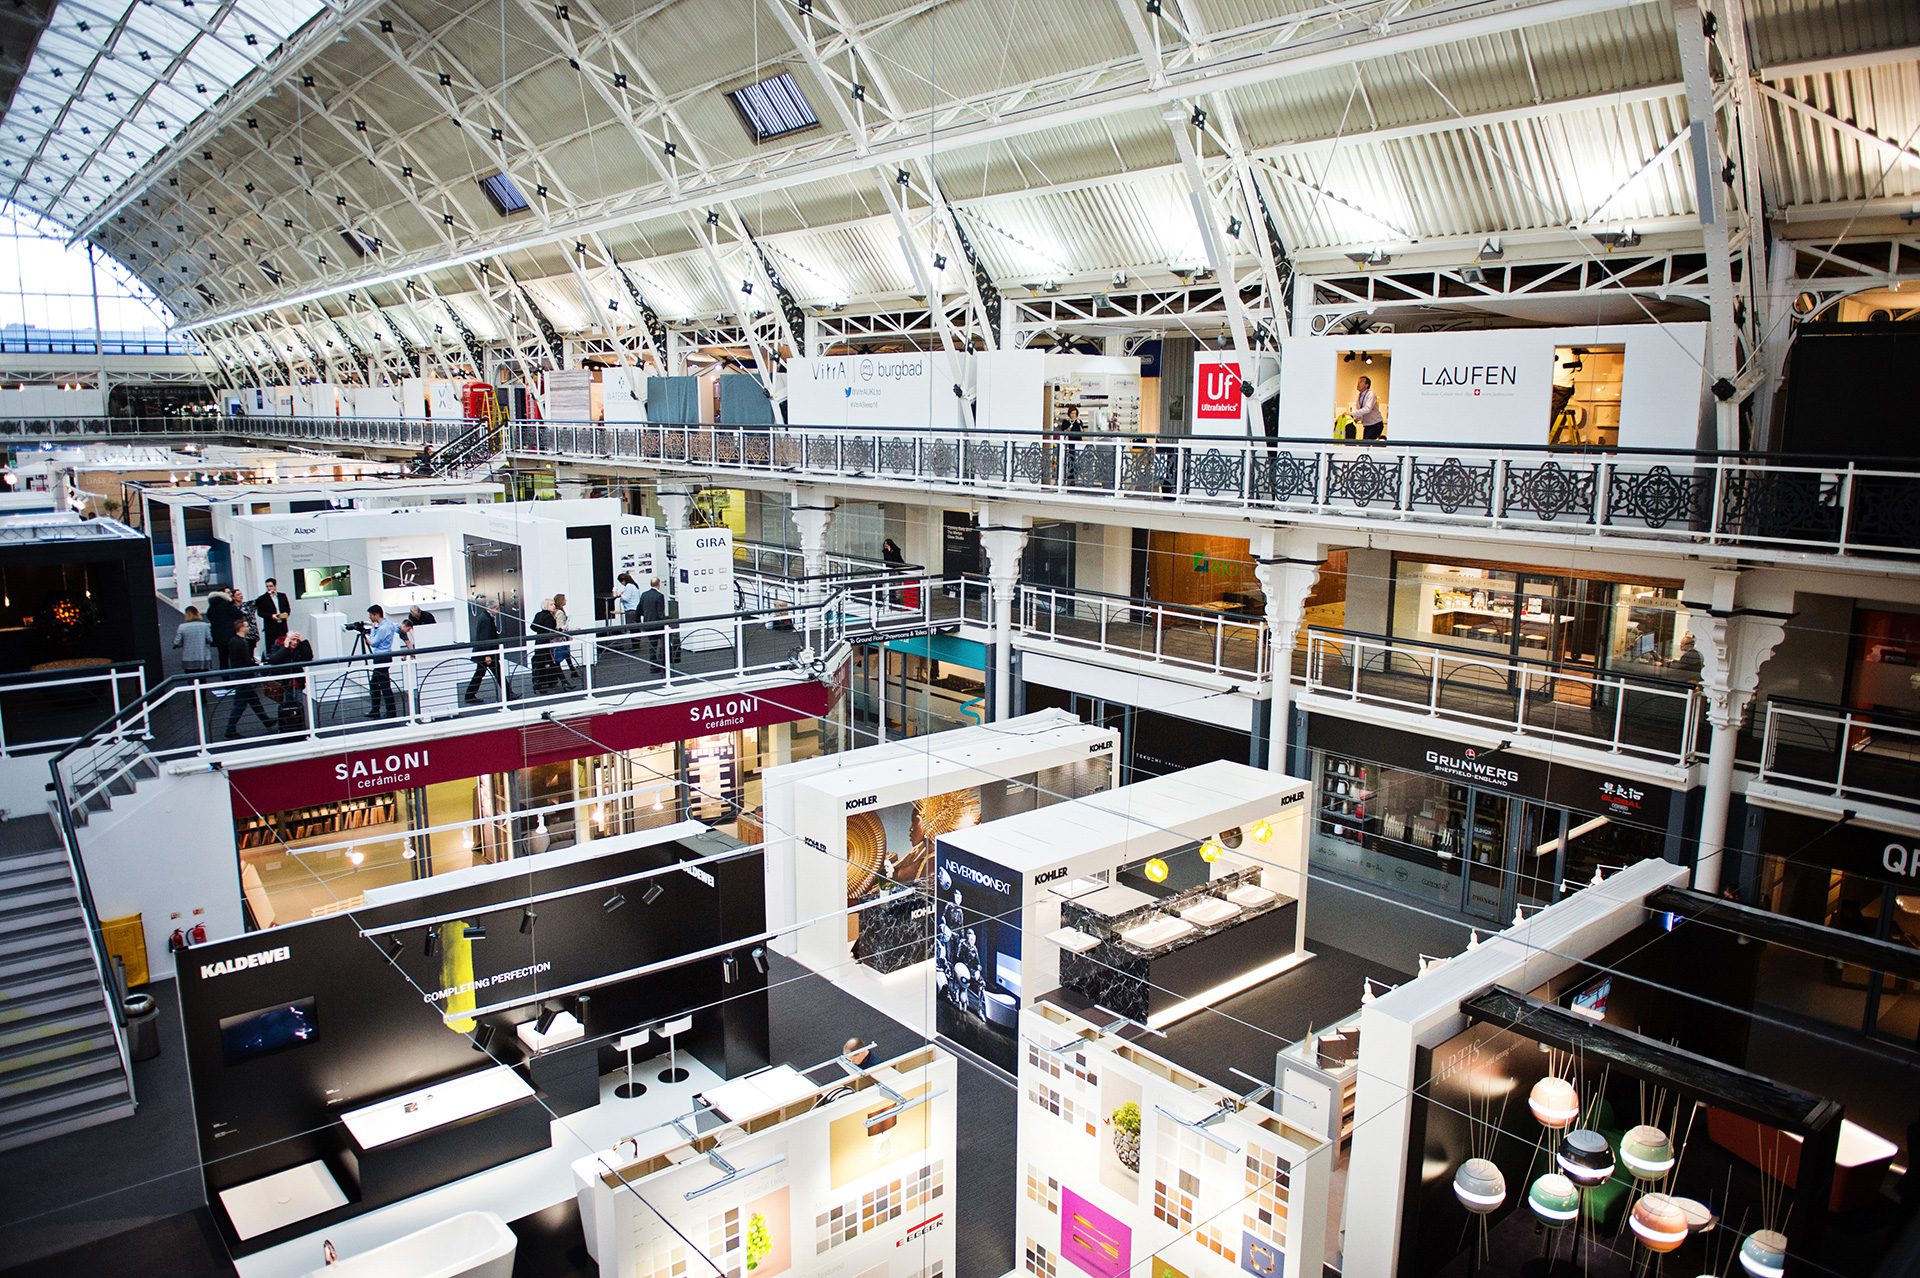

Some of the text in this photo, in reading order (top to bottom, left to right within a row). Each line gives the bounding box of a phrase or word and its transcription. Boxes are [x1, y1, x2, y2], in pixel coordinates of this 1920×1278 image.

[812, 360, 922, 380] VitrA burgbad
[1422, 366, 1516, 386] LAUFEN
[1207, 372, 1233, 400] Uf
[294, 527, 316, 535] Alape
[620, 525, 649, 535] GIRA
[696, 537, 726, 548] GIRA
[690, 697, 758, 721] SALONI
[705, 716, 744, 729] cerámica
[1089, 740, 1113, 753] KOHLER
[335, 750, 429, 780] SALONI
[1426, 751, 1519, 781] GRUNWERG
[357, 773, 411, 788] cerámica
[1434, 765, 1508, 786] SHEFFIELD-ENGLAND
[845, 795, 877, 810] KOHLER
[1281, 791, 1304, 806] KOHLER
[1601, 794, 1642, 809] GLOBAL
[945, 859, 1011, 895] NEVERTOONEXT
[1034, 866, 1068, 885] KOHLER
[200, 946, 291, 979] KALDEWEI
[423, 961, 551, 1003] COMPLETING PERFECTION
[1435, 1039, 1481, 1086] ARTIS
[907, 1219, 943, 1242] EGGER
